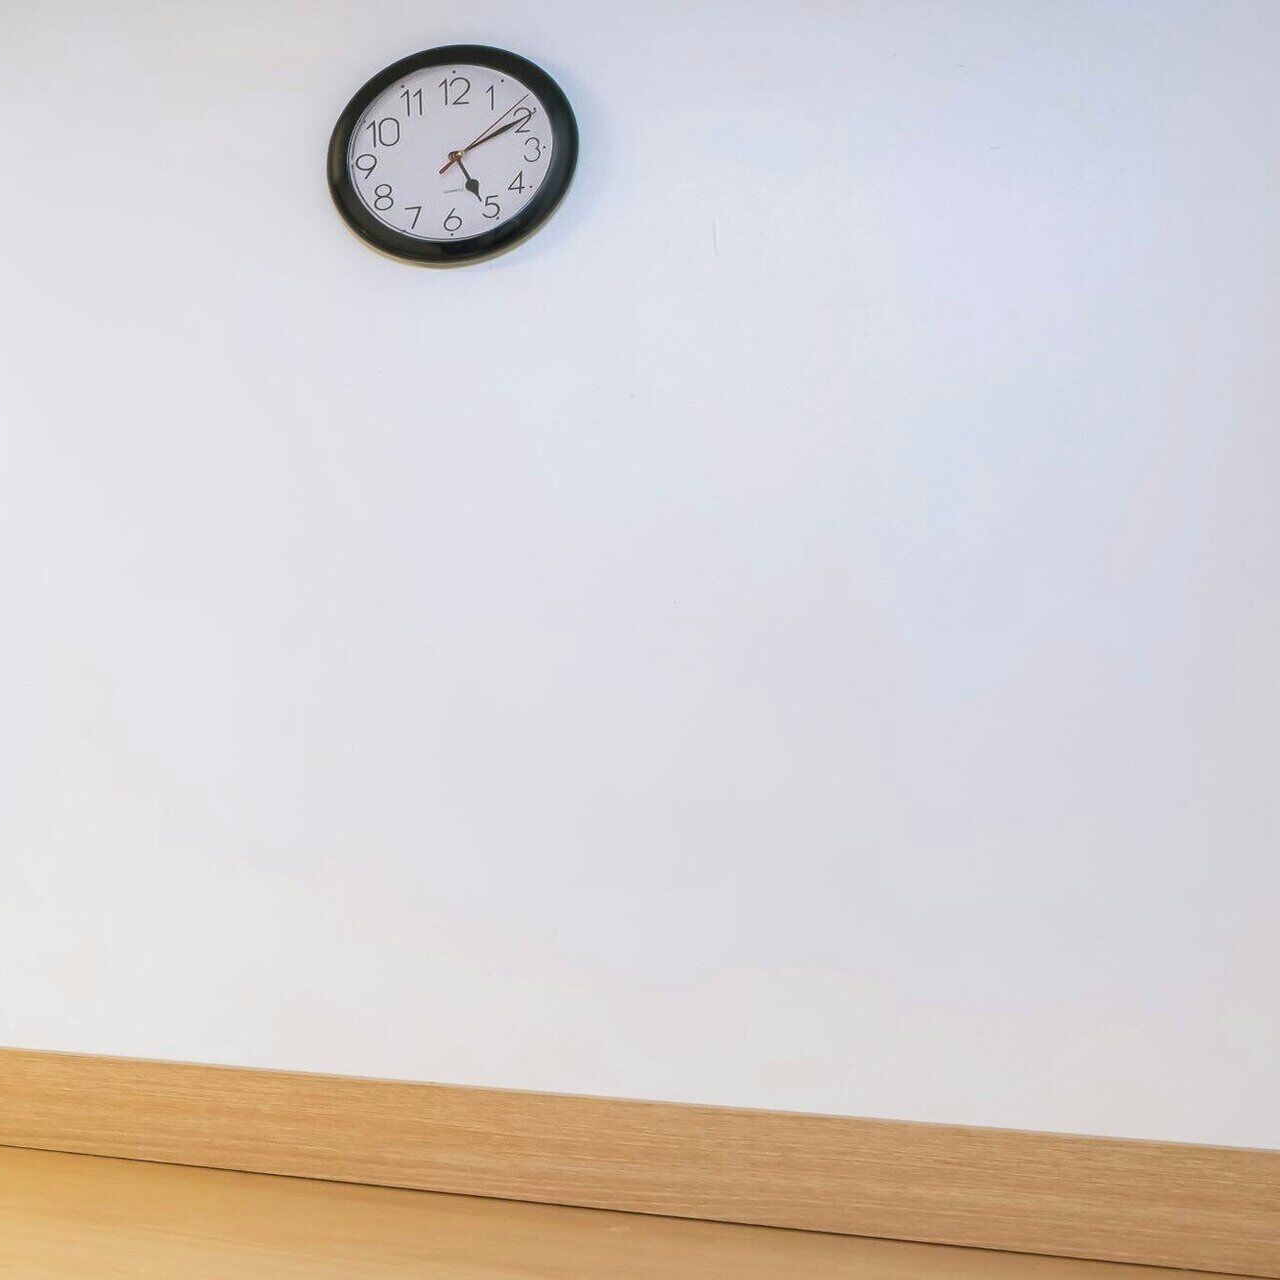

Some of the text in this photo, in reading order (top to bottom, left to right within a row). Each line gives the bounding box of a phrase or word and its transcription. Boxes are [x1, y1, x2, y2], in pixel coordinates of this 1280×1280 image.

[400, 88, 423, 117] 11
[439, 77, 471, 106] 12
[485, 84, 495, 111] 1
[366, 117, 400, 148] 10
[513, 107, 532, 134] 2
[523, 136, 541, 162] 3
[355, 153, 377, 180] 9
[507, 170, 525, 194] 4
[373, 183, 394, 211] 8
[481, 194, 501, 219] 5
[404, 205, 422, 230] 7
[443, 207, 463, 232] 6
